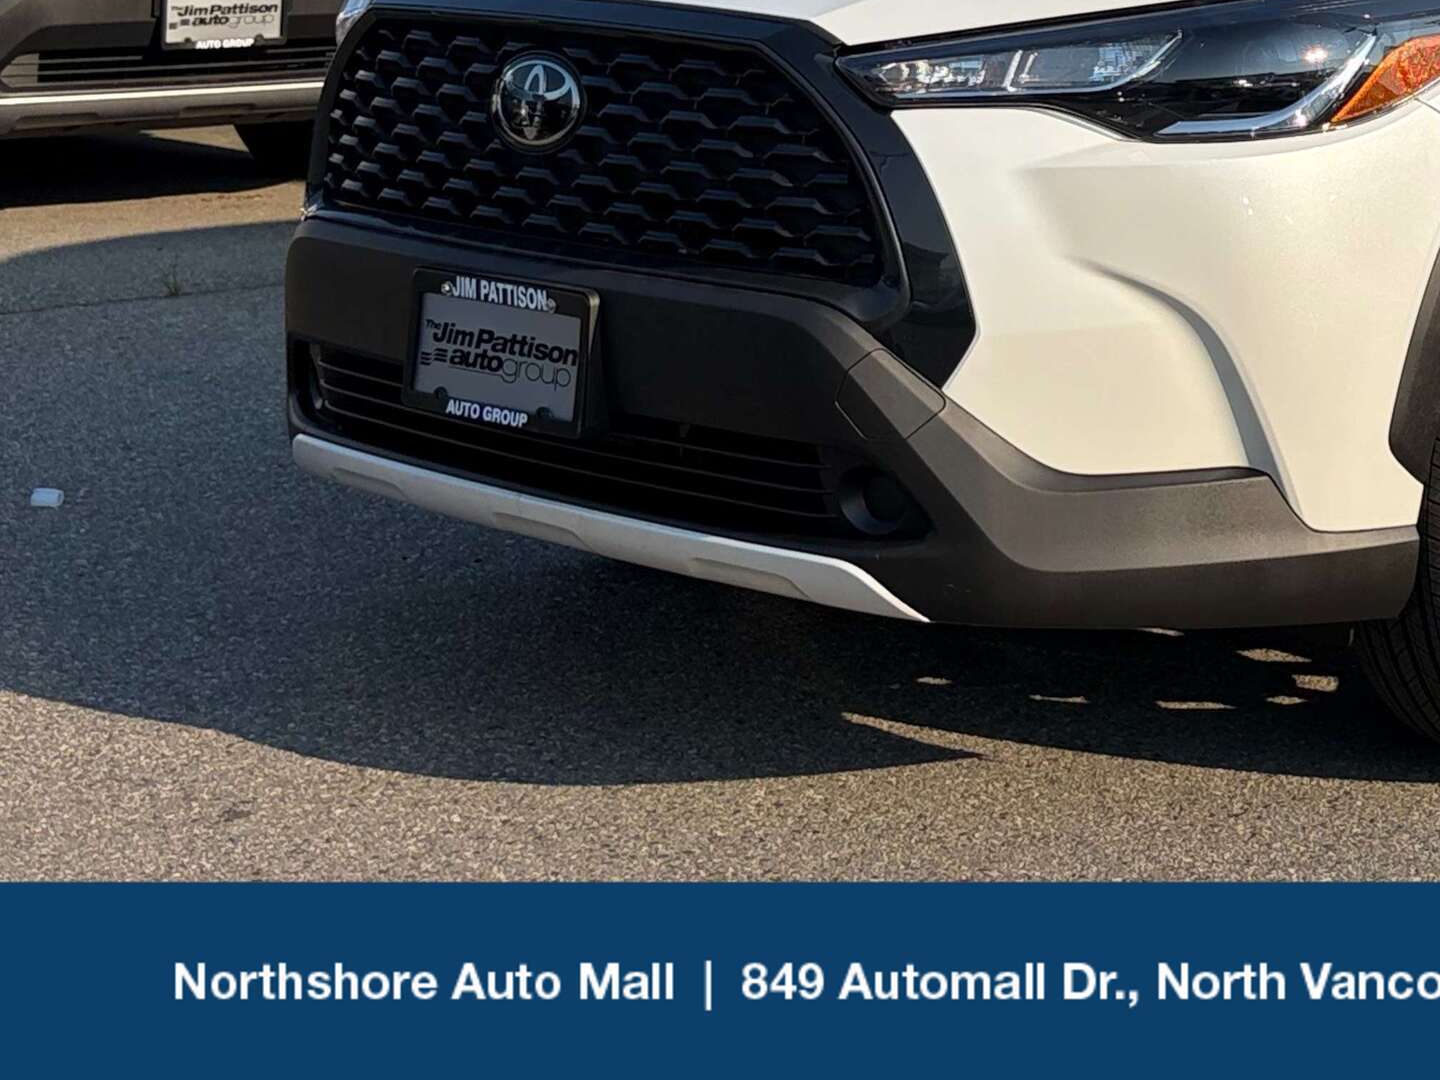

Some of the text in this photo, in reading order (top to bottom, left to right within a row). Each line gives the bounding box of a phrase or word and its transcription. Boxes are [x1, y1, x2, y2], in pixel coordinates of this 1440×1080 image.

[196, 38, 255, 50] AUTO GROUP
[451, 275, 549, 312] JIM PATTISON
[445, 398, 529, 429] AUTO GROUP
